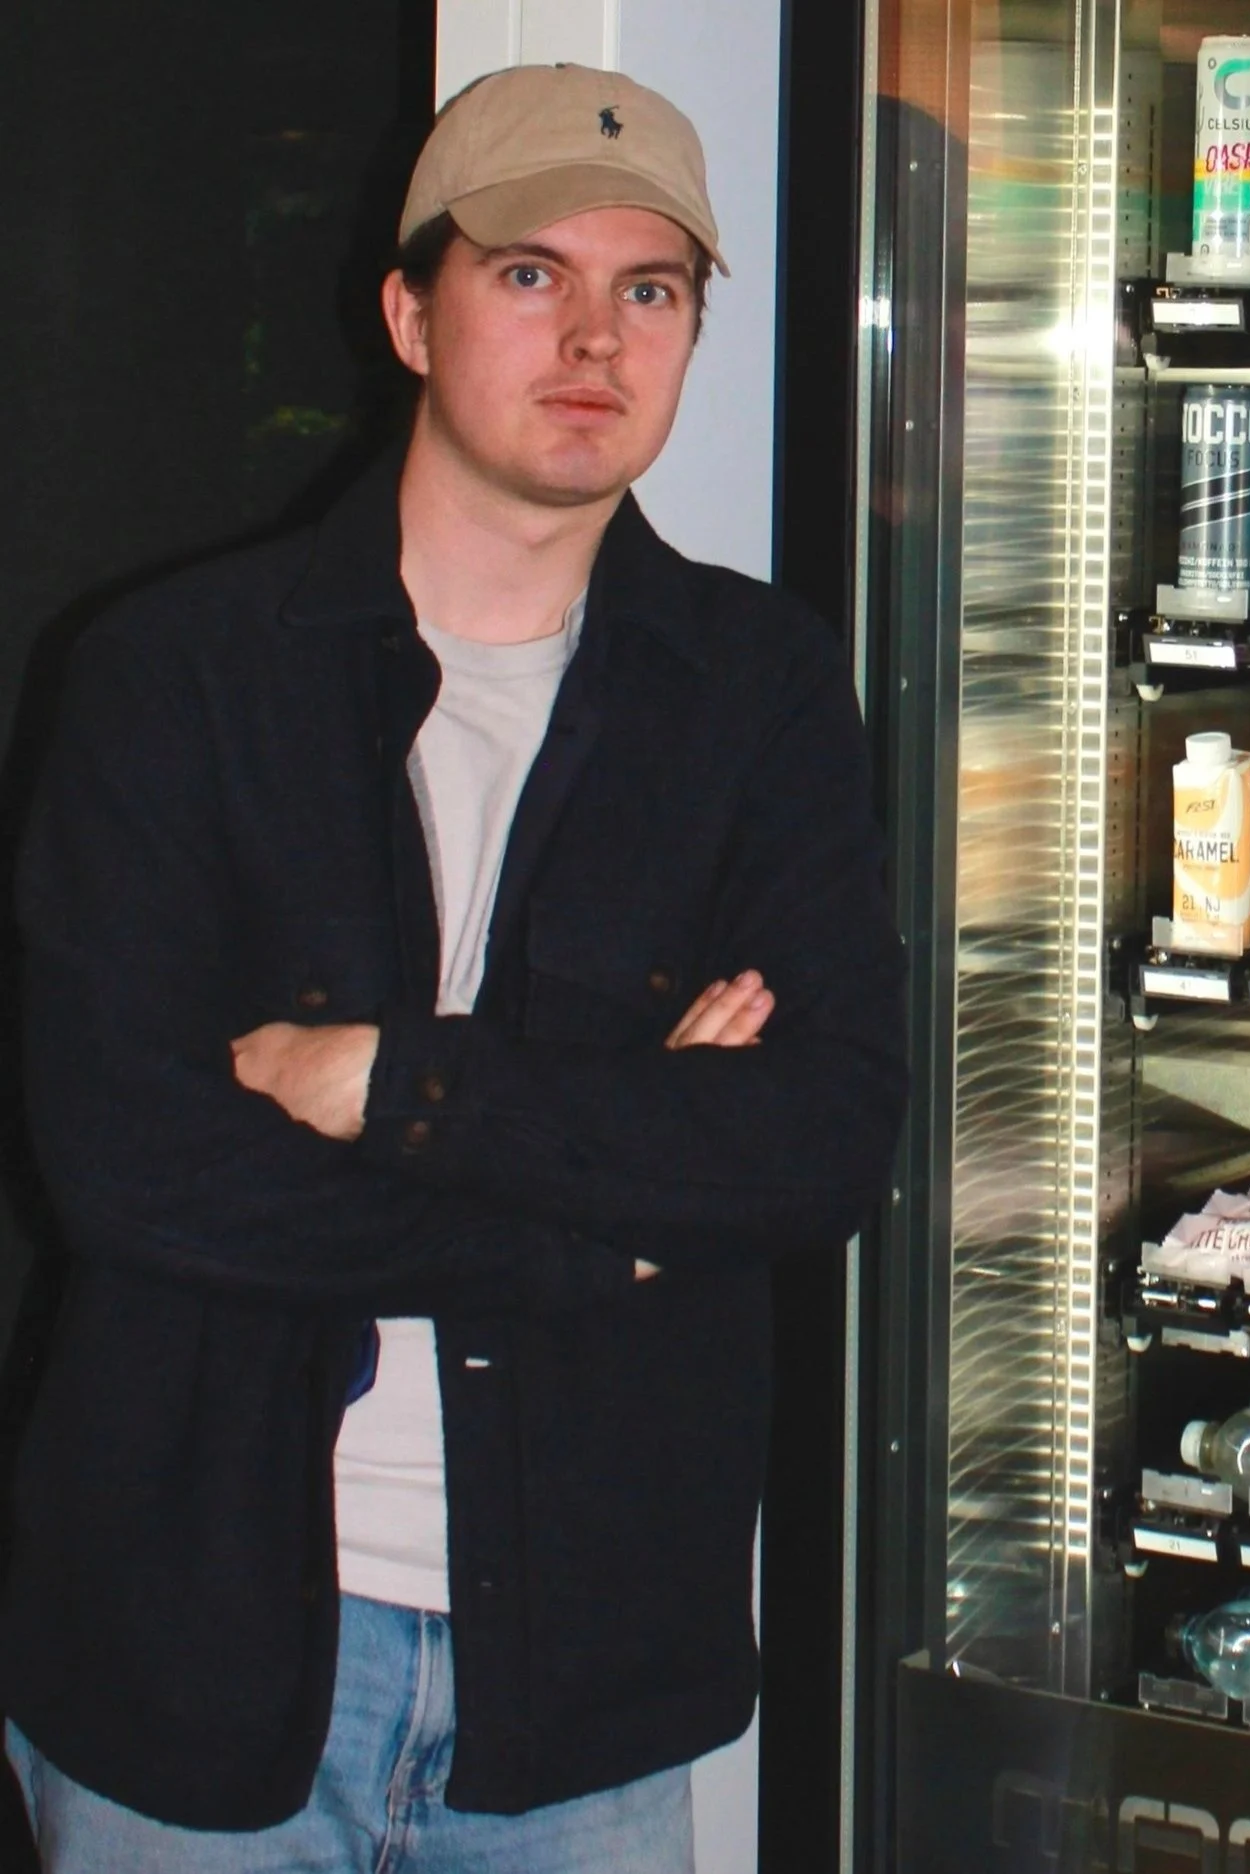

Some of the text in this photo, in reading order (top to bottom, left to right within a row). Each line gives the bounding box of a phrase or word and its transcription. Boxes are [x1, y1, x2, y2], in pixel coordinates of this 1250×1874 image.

[1187, 449, 1240, 469] FOCUS
[1185, 649, 1198, 661] 51
[1192, 1227, 1225, 1250] ITE
[1169, 1540, 1181, 1550] 21
